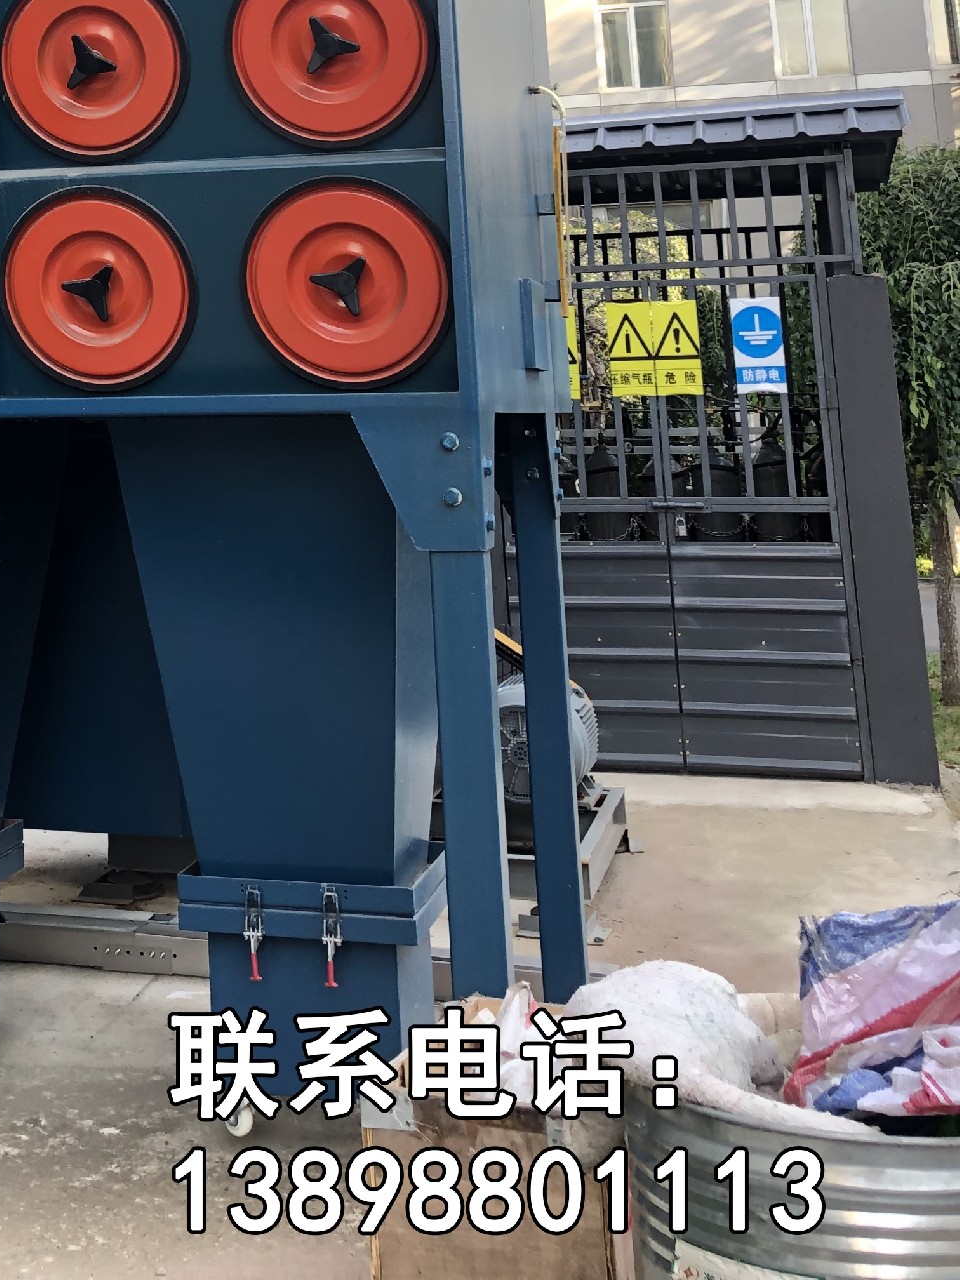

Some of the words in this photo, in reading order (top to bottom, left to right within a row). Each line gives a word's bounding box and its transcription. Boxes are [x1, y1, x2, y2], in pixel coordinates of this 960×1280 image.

[665, 371, 697, 384] 危险
[742, 368, 781, 382] 防静电
